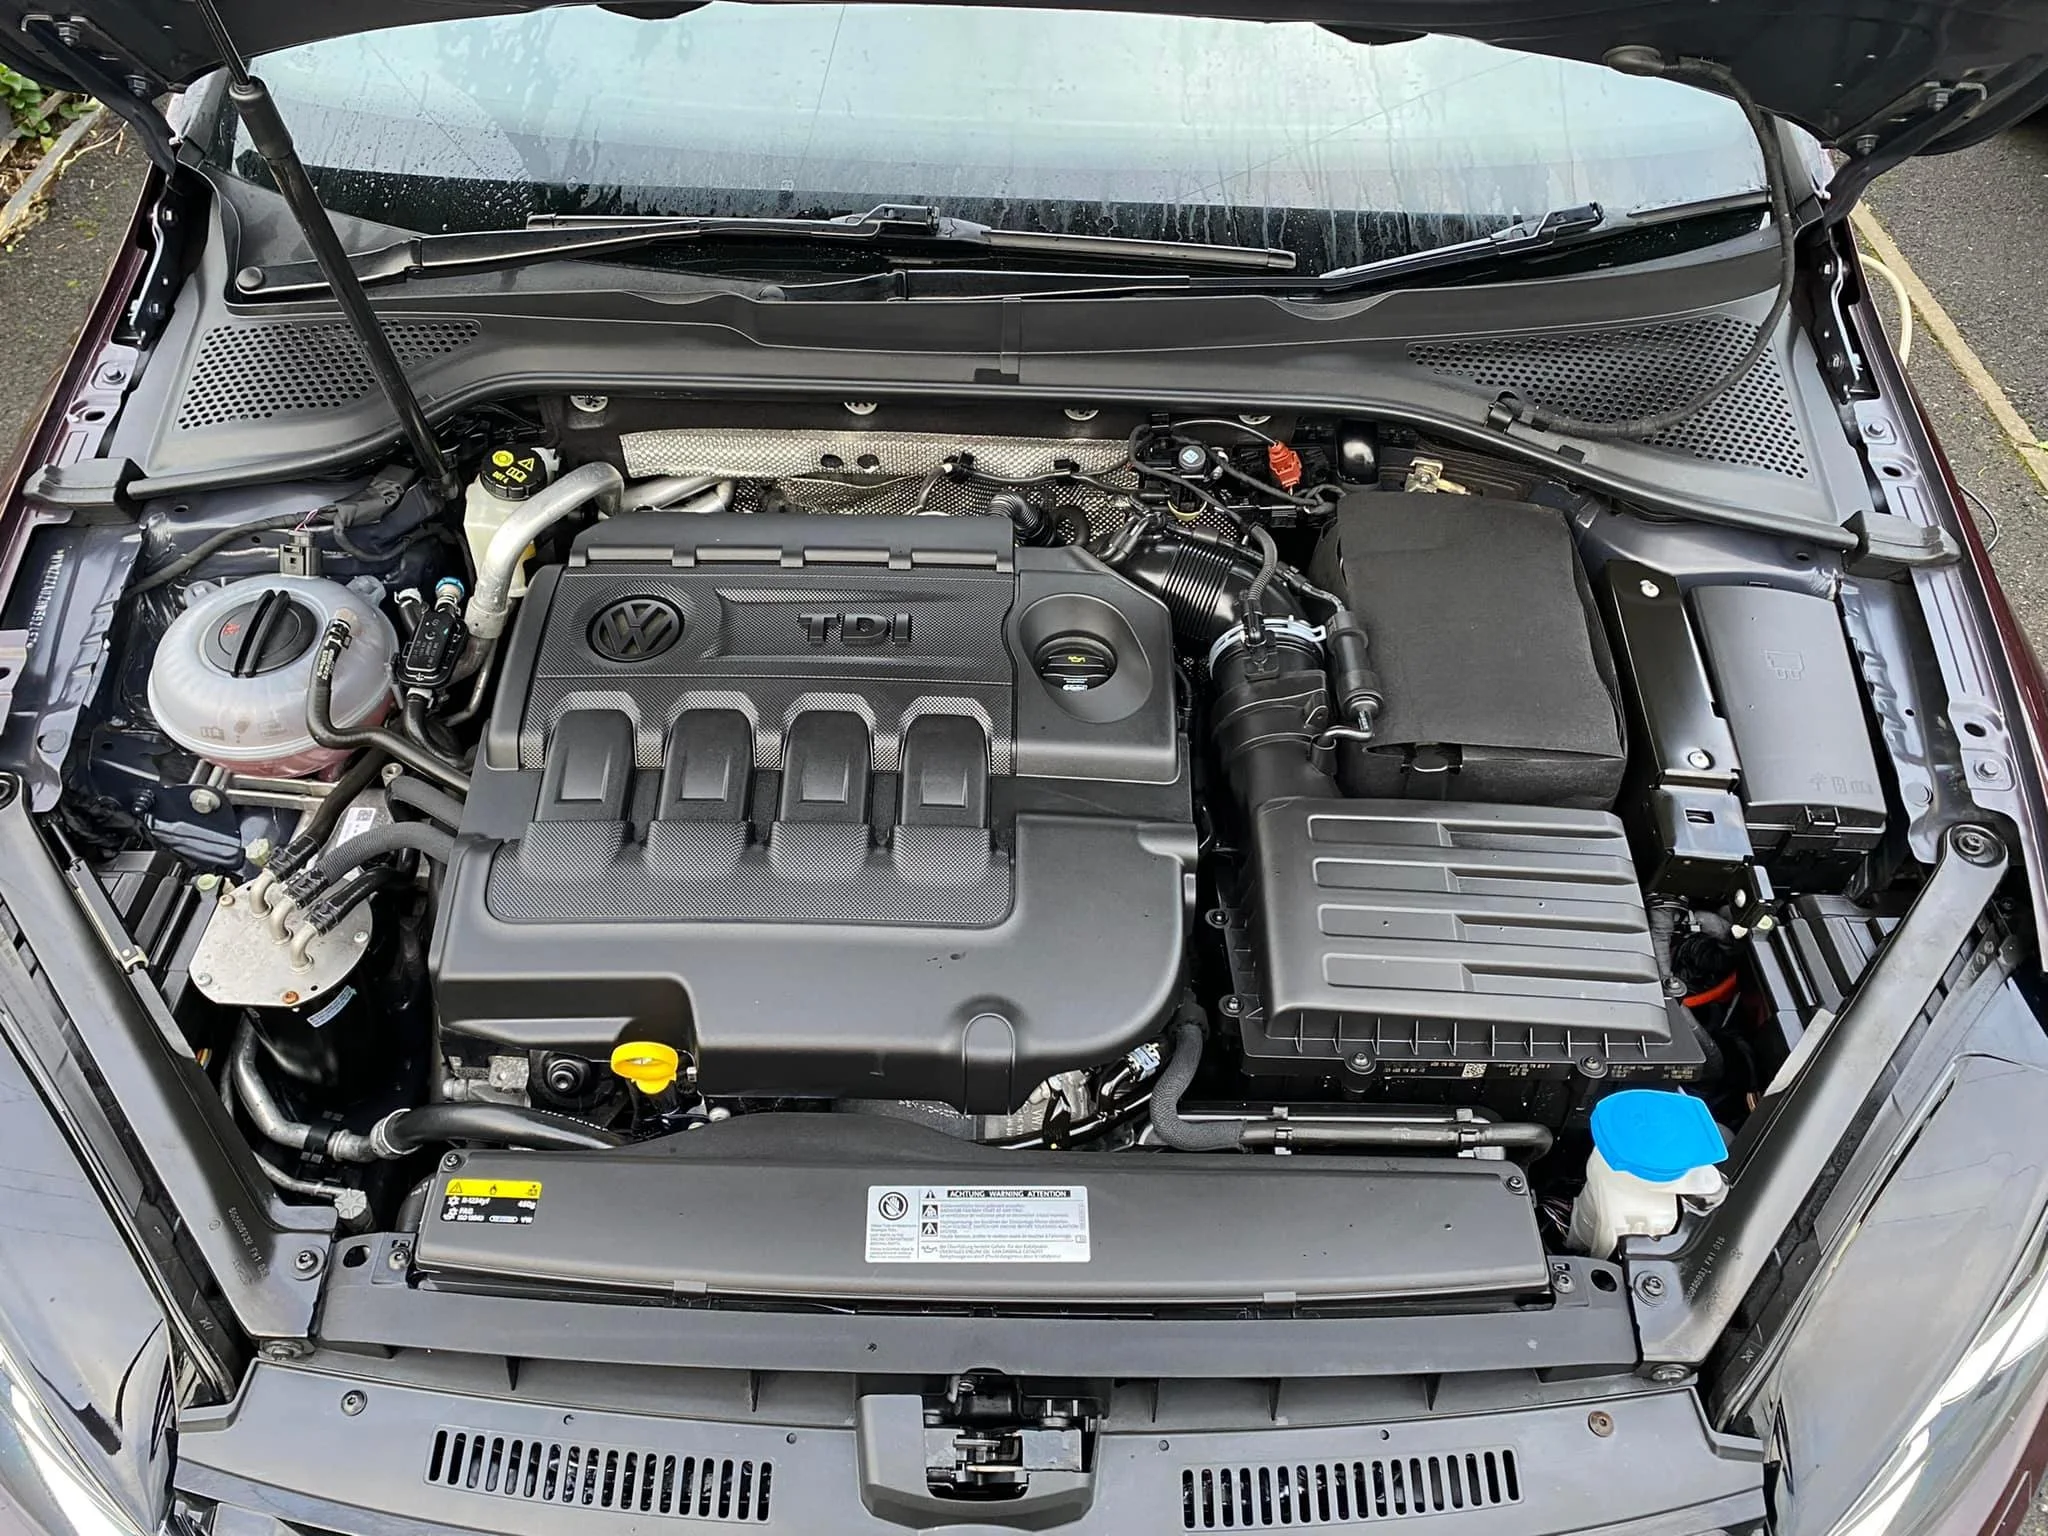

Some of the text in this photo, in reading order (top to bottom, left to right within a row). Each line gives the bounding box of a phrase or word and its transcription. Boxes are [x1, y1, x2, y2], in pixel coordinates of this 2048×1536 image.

[798, 612, 912, 646] TDI
[949, 1190, 1067, 1198] ACHTUNG WARNING ATTENTION
